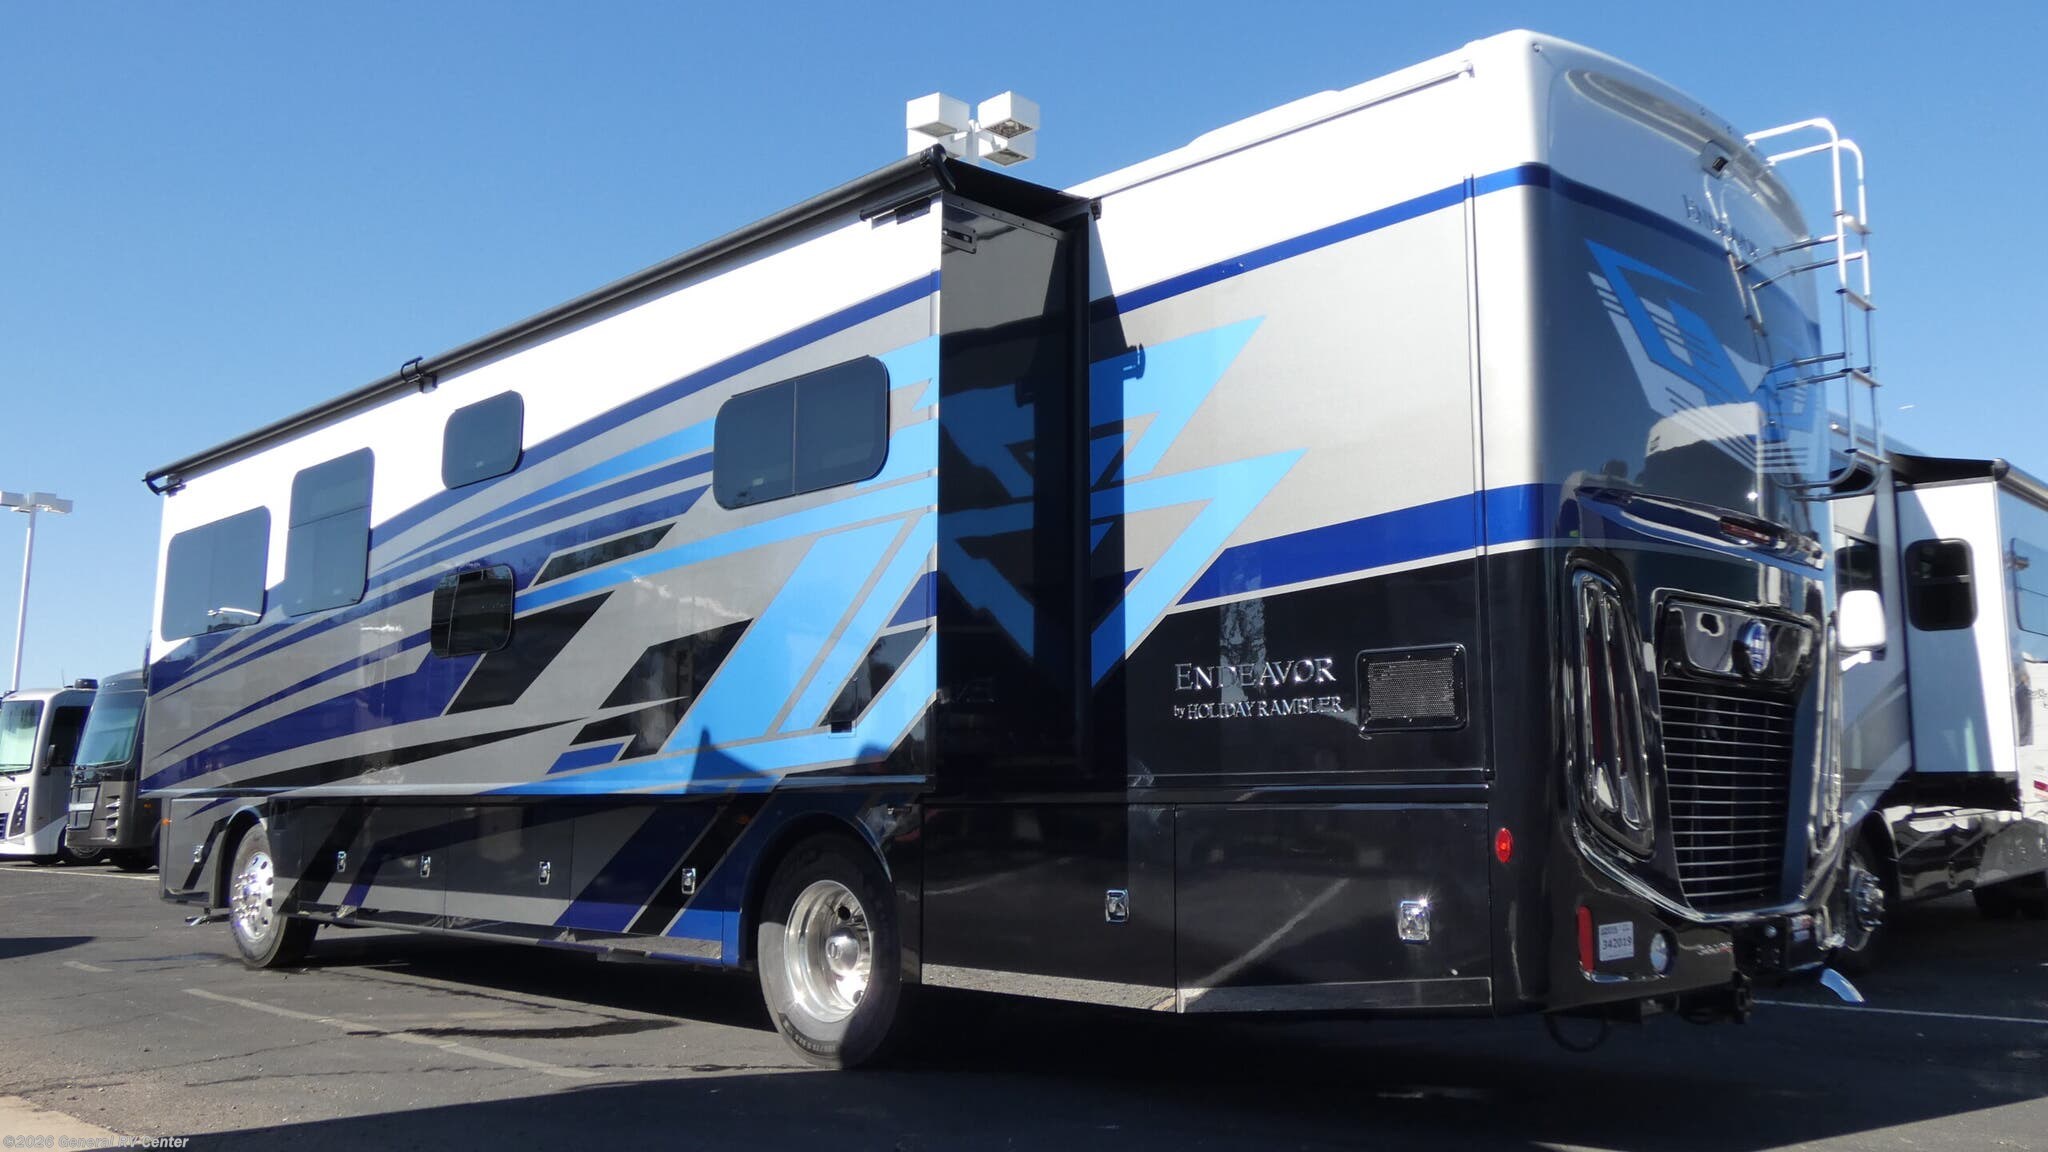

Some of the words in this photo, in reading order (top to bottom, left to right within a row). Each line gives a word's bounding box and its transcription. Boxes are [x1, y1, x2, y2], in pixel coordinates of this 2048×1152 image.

[1174, 658, 1337, 691] ENDEAVOR
[1173, 704, 1186, 719] by
[1187, 700, 1256, 720] HOLIDAY
[1257, 696, 1344, 717] RAMBLER
